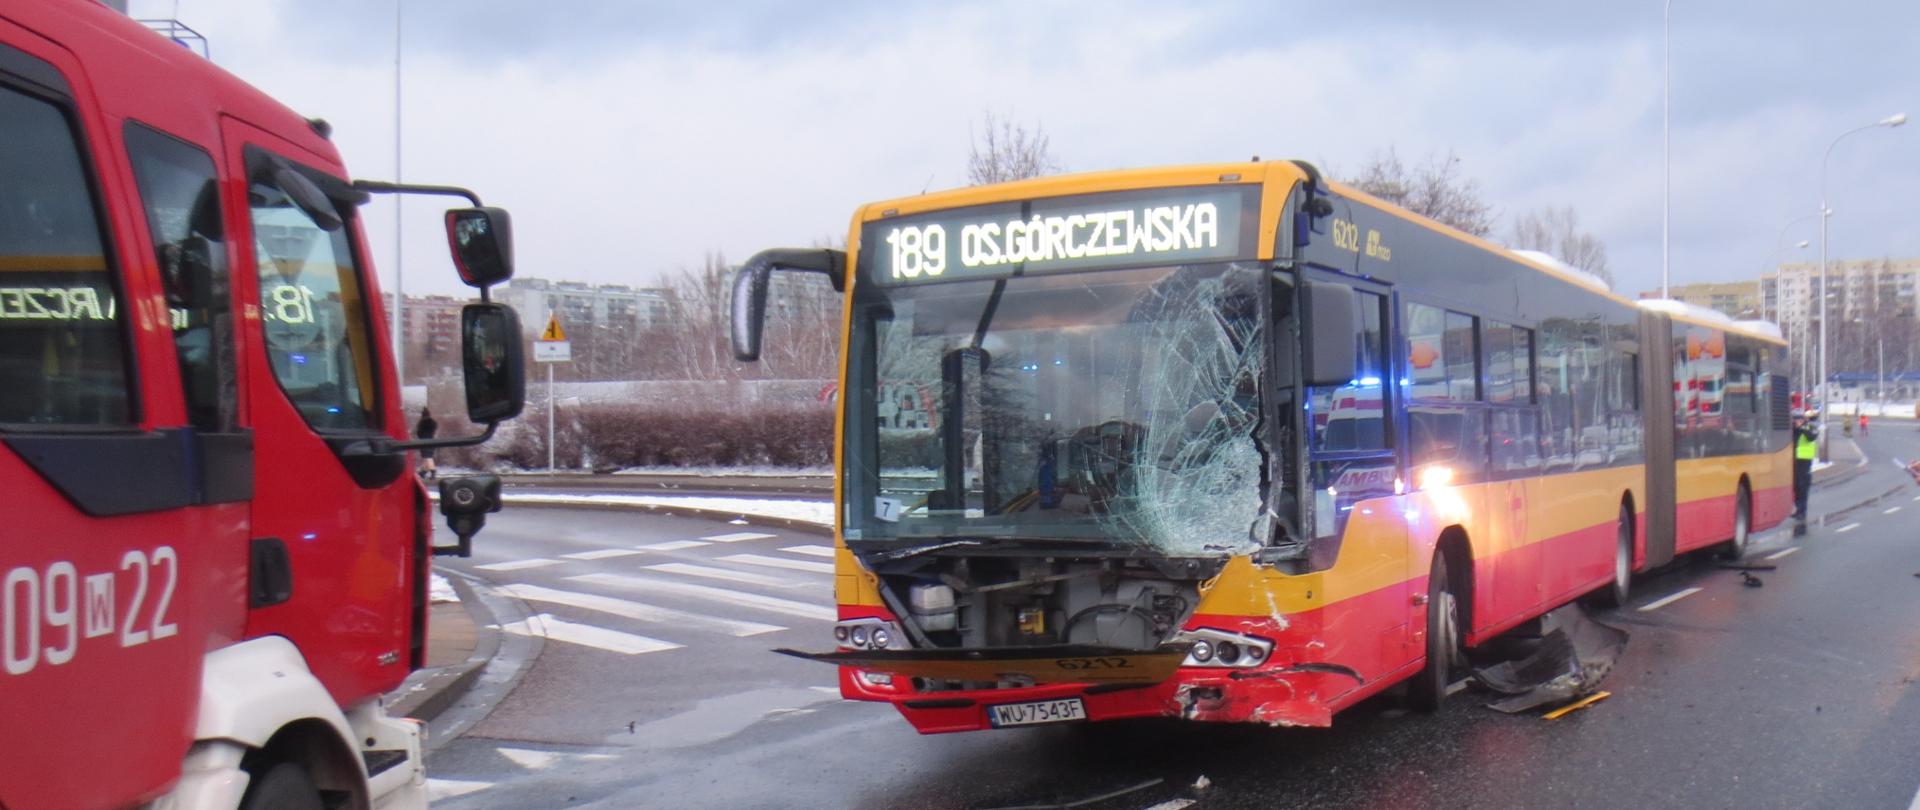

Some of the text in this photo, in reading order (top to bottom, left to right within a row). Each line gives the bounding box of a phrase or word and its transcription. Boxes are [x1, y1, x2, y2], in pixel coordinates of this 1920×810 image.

[1333, 218, 1359, 252] 6212
[886, 224, 946, 279] 189
[883, 501, 891, 518] 7
[1055, 657, 1135, 671] 6212
